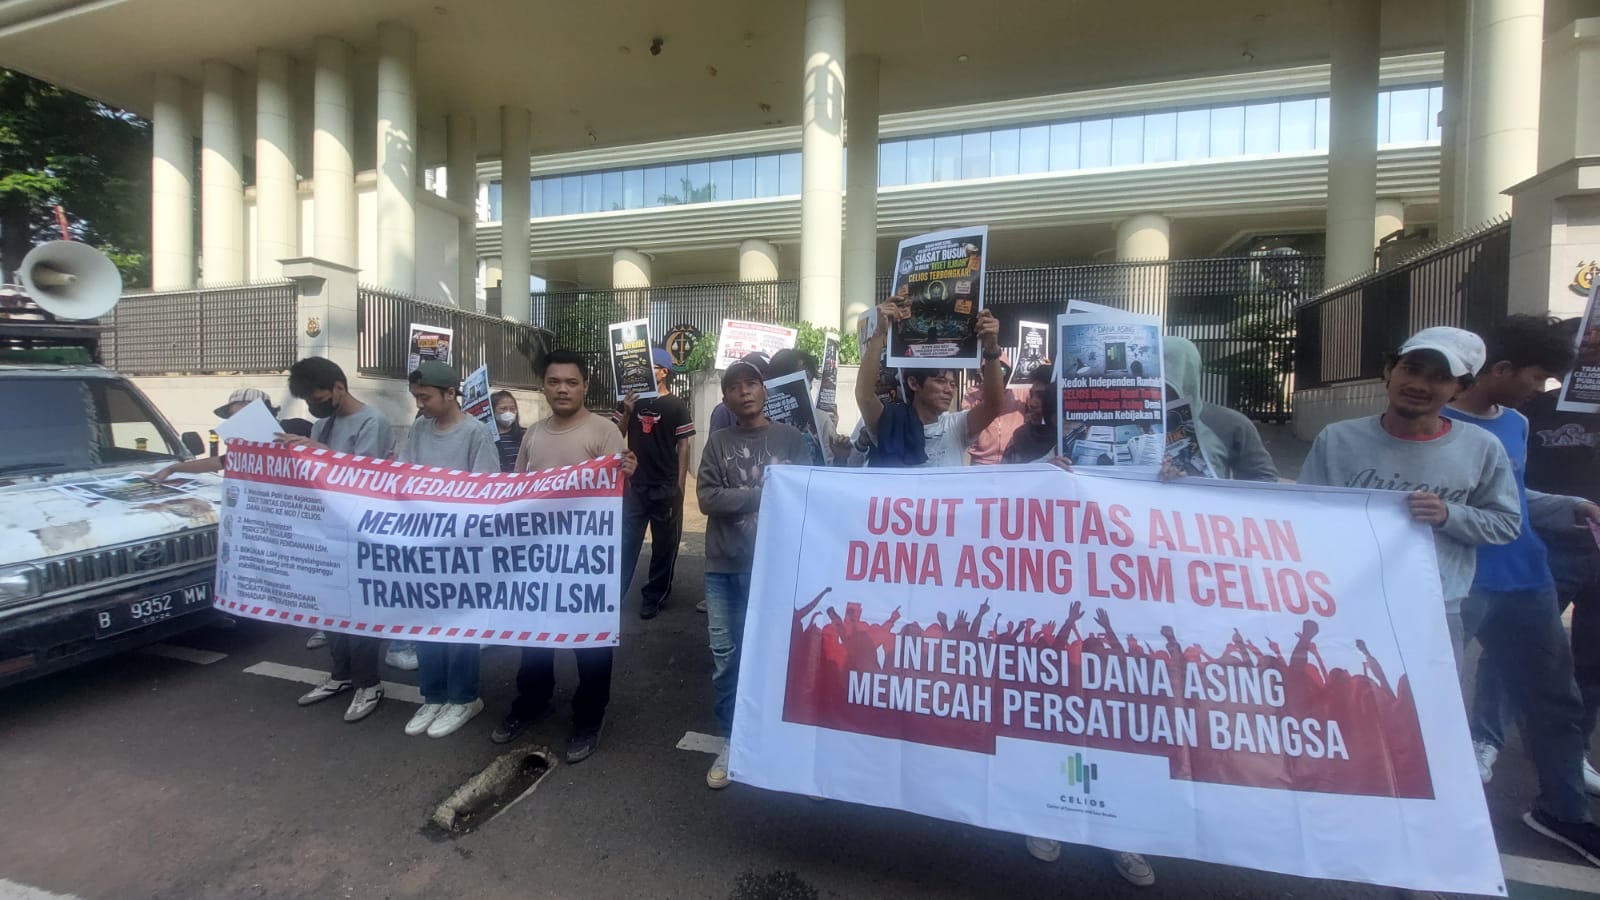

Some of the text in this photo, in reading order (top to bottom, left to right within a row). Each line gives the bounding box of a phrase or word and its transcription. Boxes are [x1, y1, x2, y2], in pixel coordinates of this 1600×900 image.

[914, 250, 940, 265] SIASAT
[909, 272, 929, 282] CELIOS
[1062, 377, 1087, 388] Kedok
[1089, 377, 1136, 389] Independen
[1066, 411, 1113, 421] Lumpuhkan
[1115, 410, 1153, 421] Kebijakan
[226, 451, 618, 499] SUARA RAKYAT UNTUK KEDAULATAN NEGARA!
[357, 510, 614, 538] MEMINTA PEMERINTAH
[867, 497, 1302, 562] USUT TUNTAS ALIRAN
[357, 543, 615, 575] PERKETAT REGULASI
[845, 540, 1337, 617] DANA ASING LSM CELIOS
[98, 585, 206, 629] B 9352 MW
[358, 578, 615, 613] TRANSPARANSI LSM.
[893, 634, 1285, 707] INTERVENSI DANA ASING
[848, 671, 1350, 760] MEMECAH PERSATUAN BANGSA
[1060, 795, 1105, 808] CELIOS
